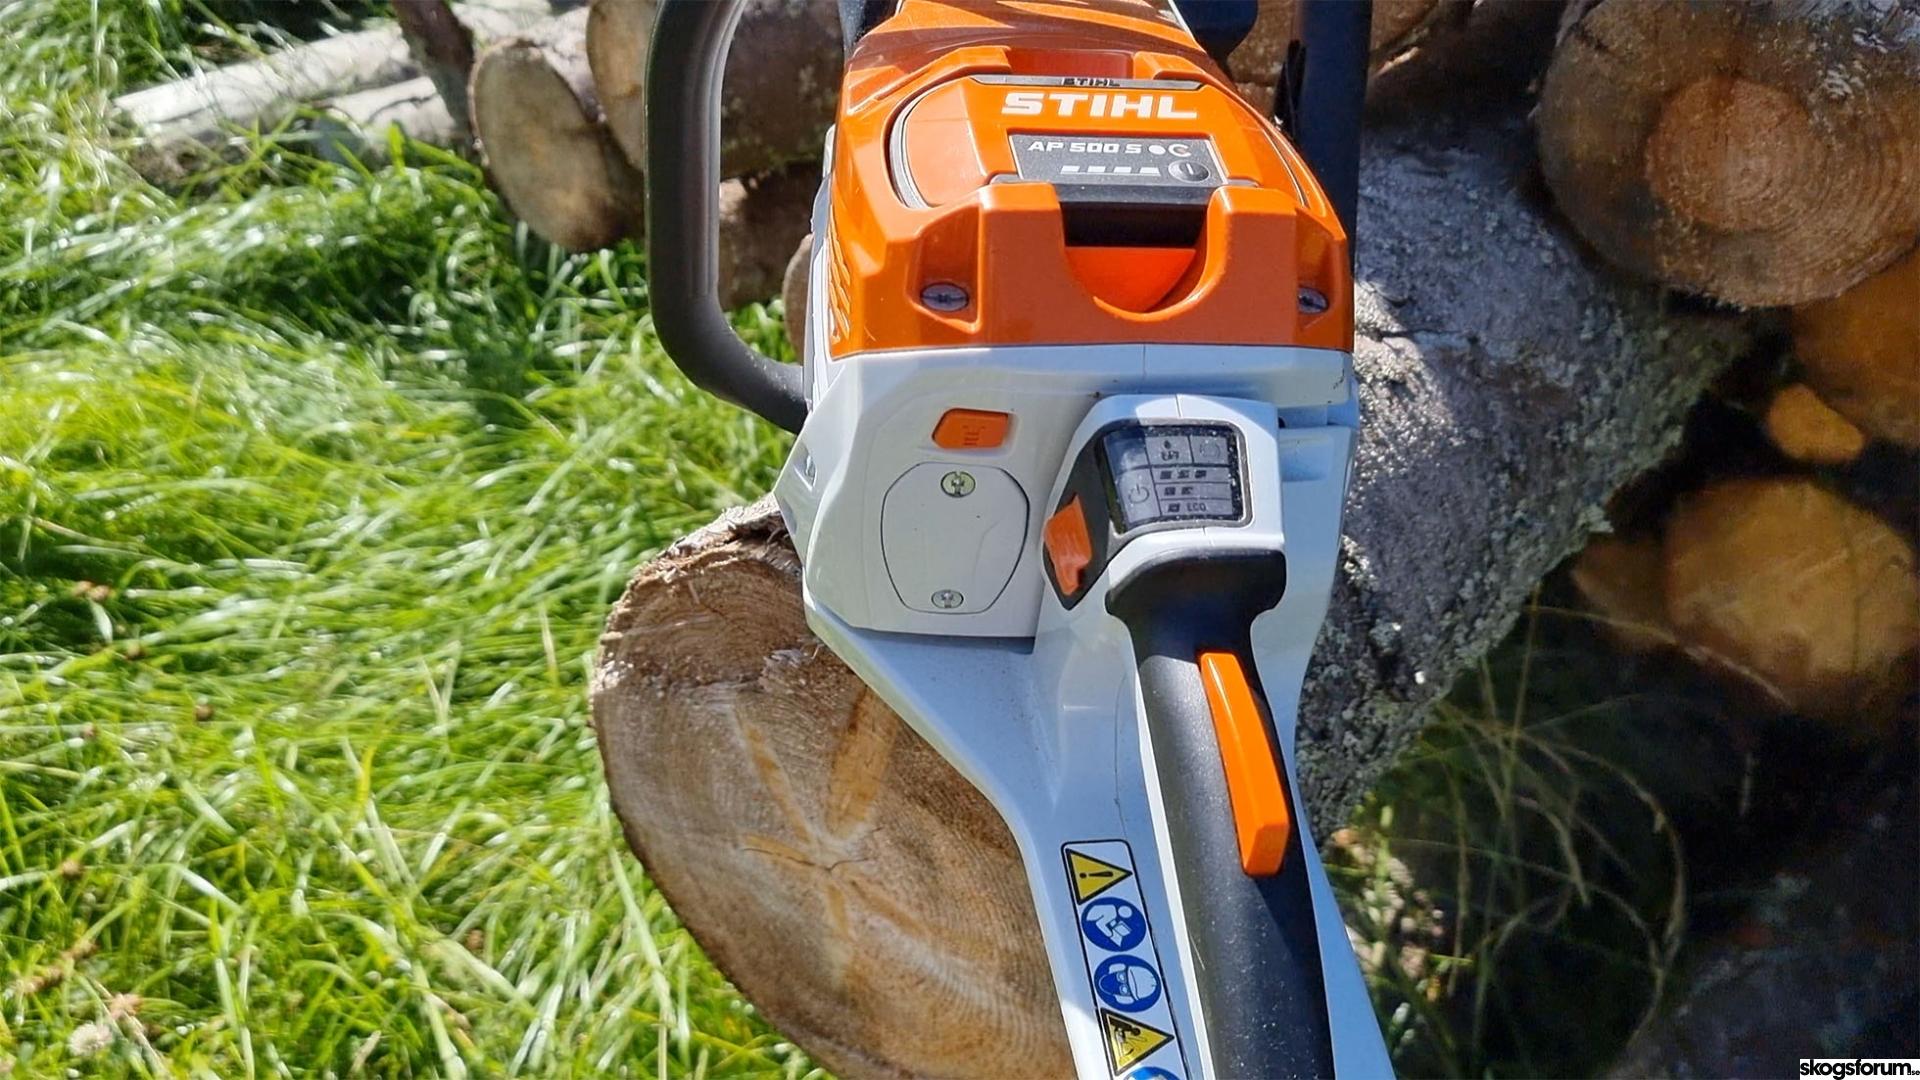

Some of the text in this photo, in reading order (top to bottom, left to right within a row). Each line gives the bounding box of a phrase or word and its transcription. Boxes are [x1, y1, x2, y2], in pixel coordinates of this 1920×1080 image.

[1063, 77, 1120, 88] STIHL
[1001, 92, 1198, 119] STIHL
[1027, 141, 1064, 152] AP
[1069, 142, 1119, 154] 500
